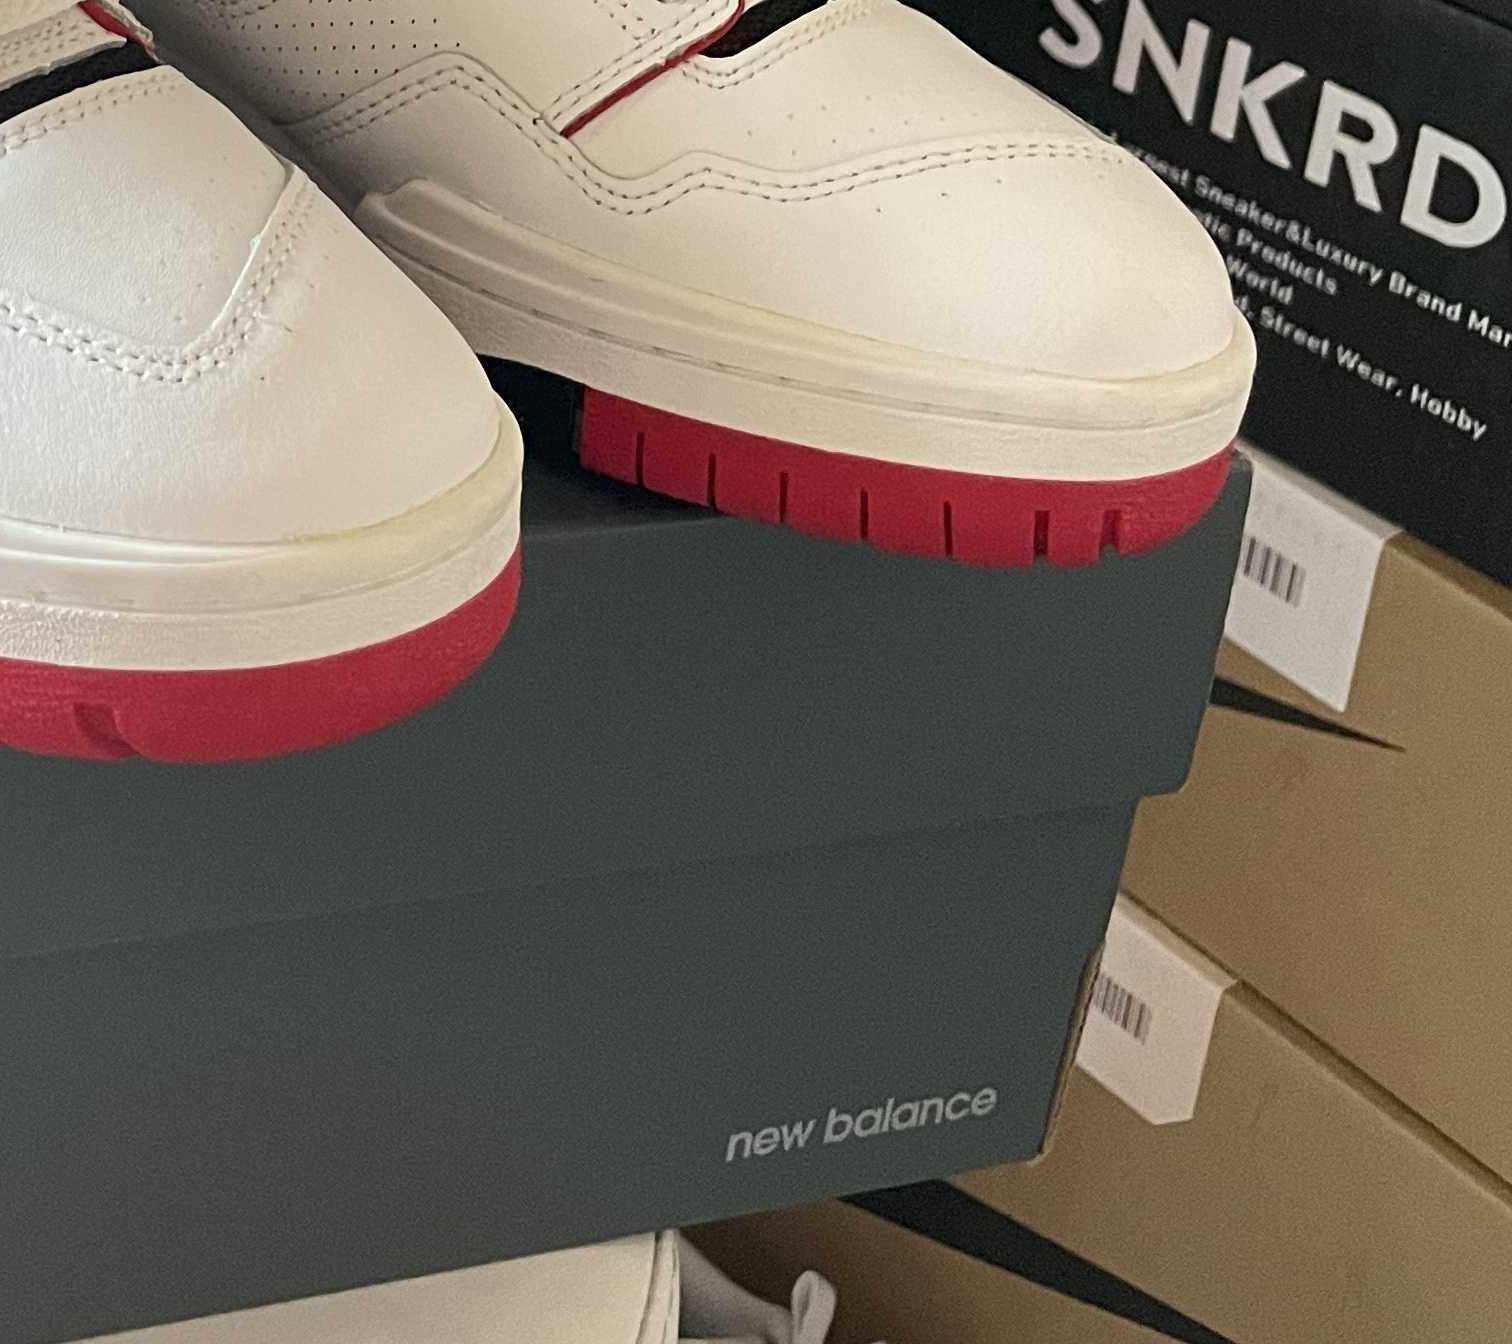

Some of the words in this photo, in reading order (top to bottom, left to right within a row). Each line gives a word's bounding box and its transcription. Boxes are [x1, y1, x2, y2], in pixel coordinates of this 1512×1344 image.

[1236, 228, 1337, 295] Products
[1389, 271, 1462, 323] Brand
[1259, 306, 1330, 359] Street
[1410, 384, 1487, 441] Hobby
[726, 1119, 816, 1162] new
[823, 1087, 998, 1144] balance
